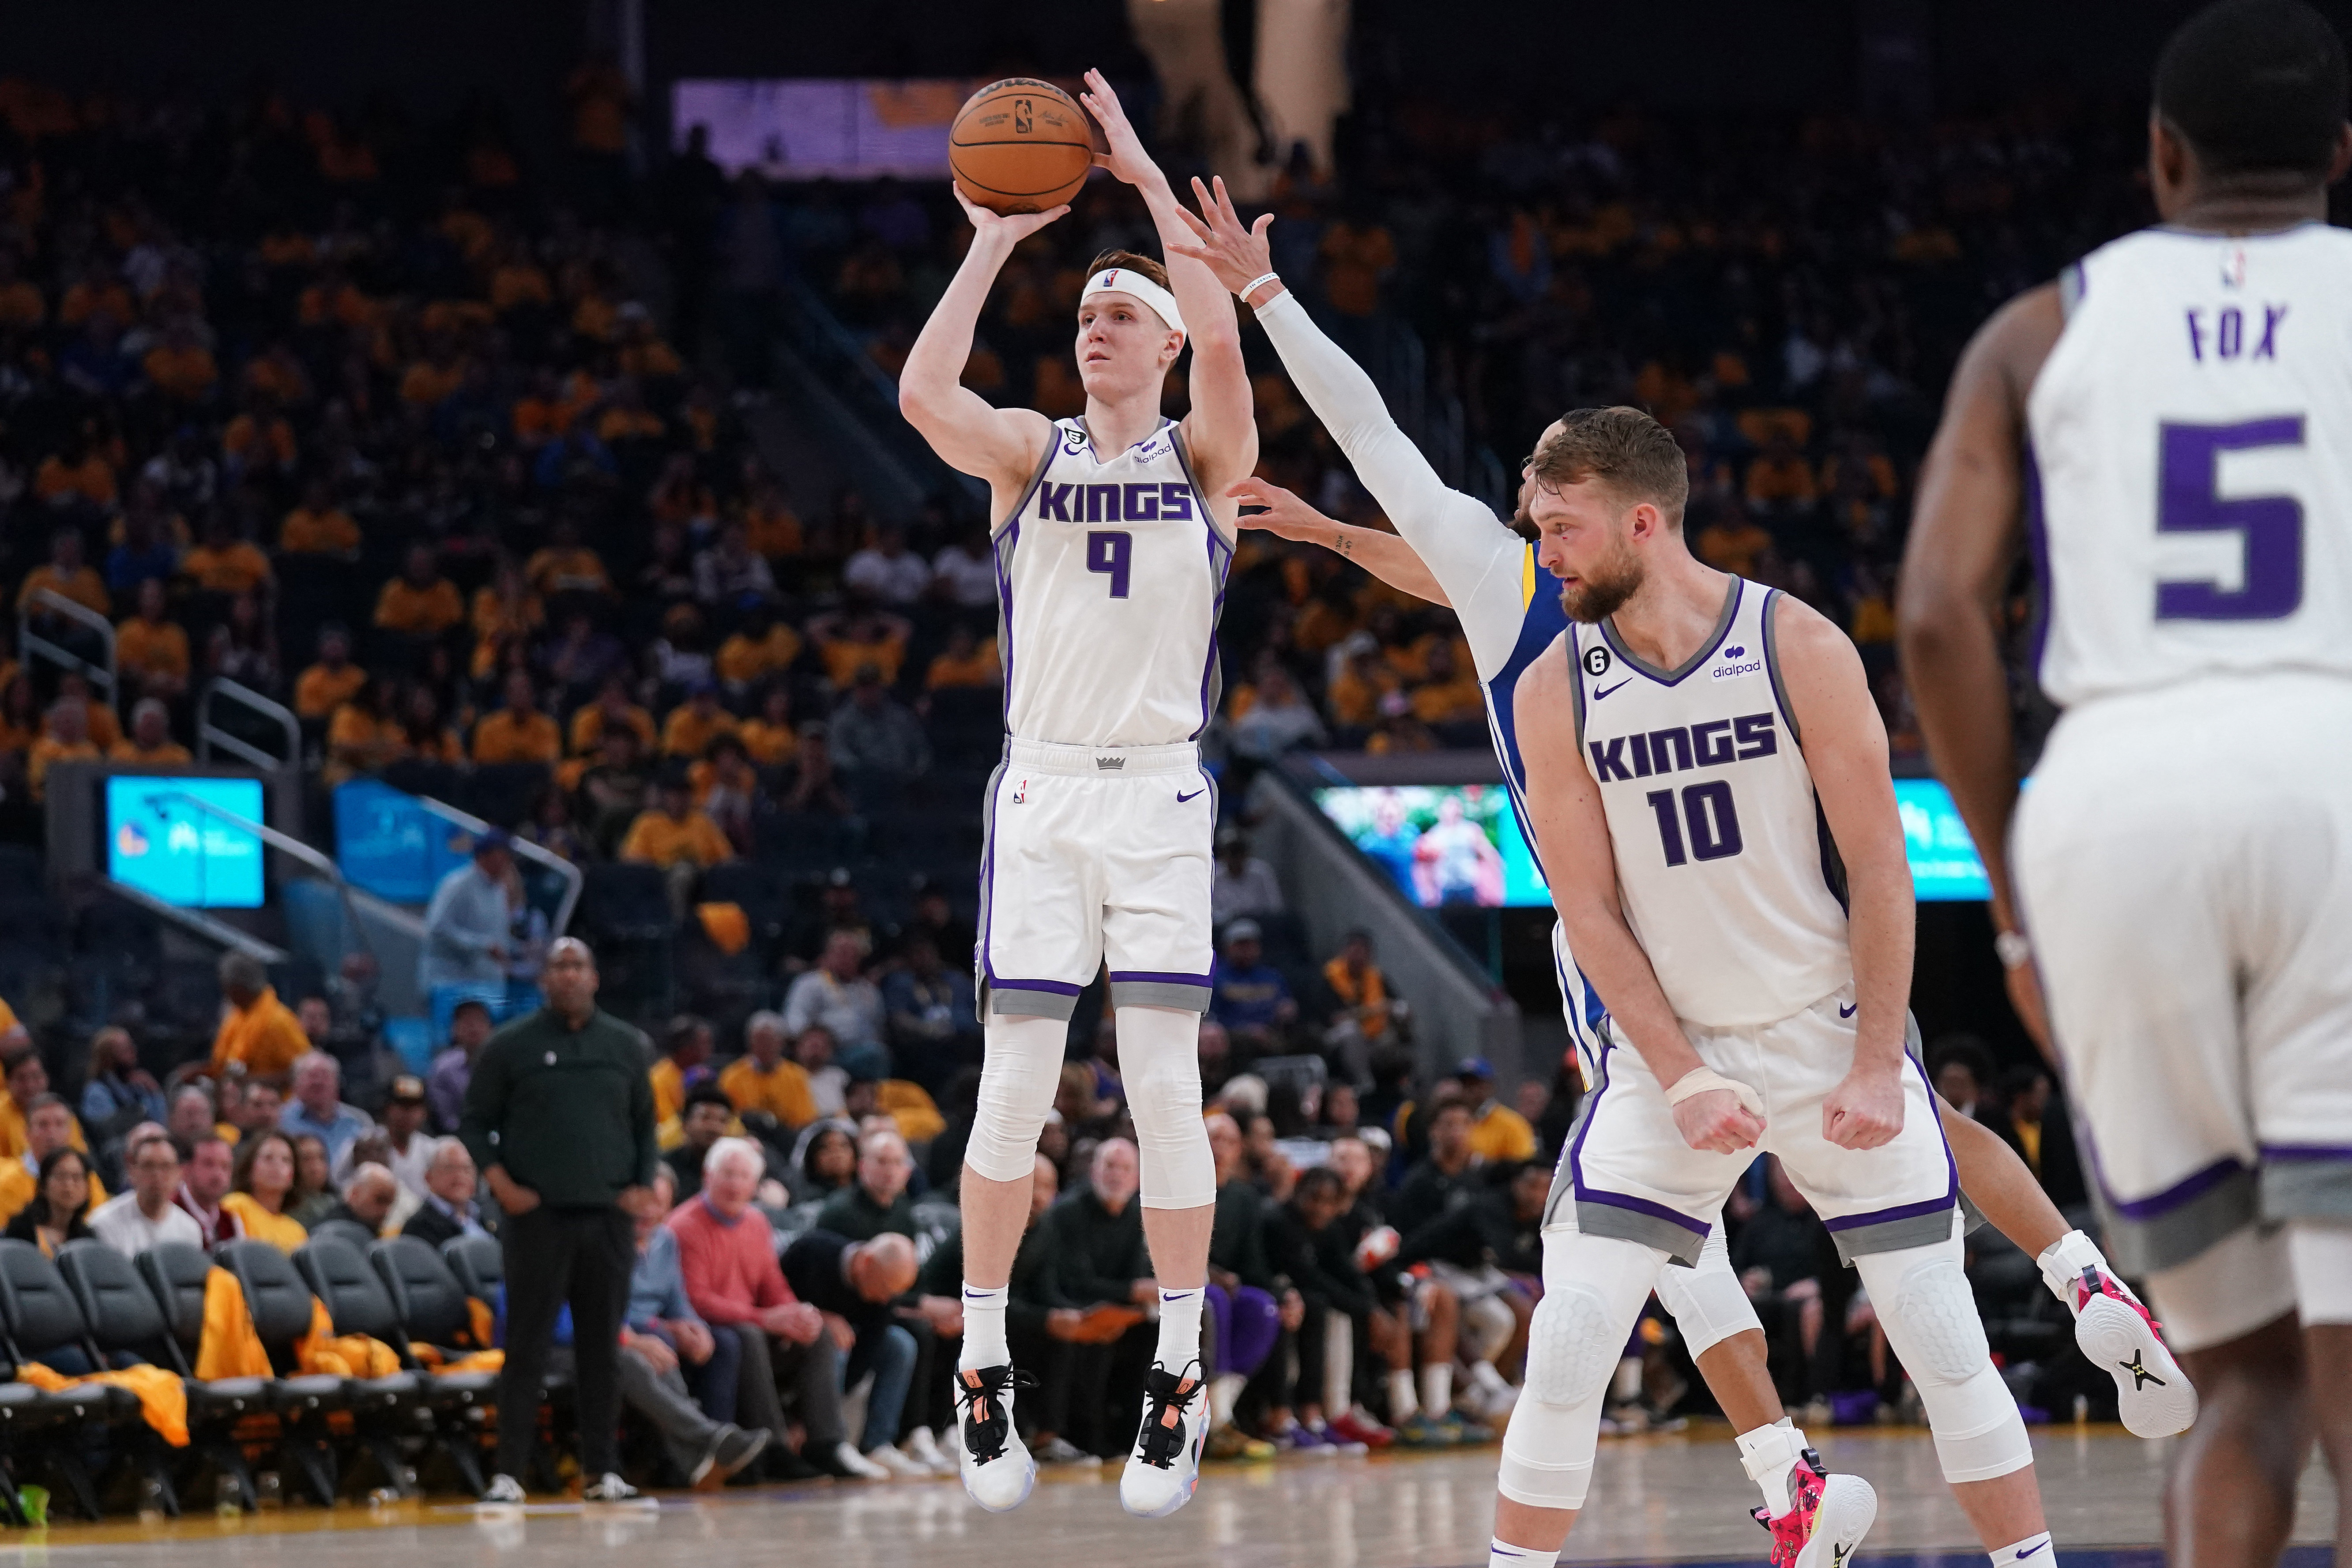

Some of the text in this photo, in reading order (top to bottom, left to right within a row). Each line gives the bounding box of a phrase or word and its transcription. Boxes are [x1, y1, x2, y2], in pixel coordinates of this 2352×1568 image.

[2185, 303, 2290, 362] FOX
[1039, 481, 1193, 523] KINGS
[2154, 413, 2306, 621] 5
[1087, 530, 1133, 599] 9
[1590, 650, 1605, 673] 6
[1713, 659, 1761, 678] dialpad
[1588, 712, 1778, 783] KINGS
[1646, 780, 1744, 867] 10
